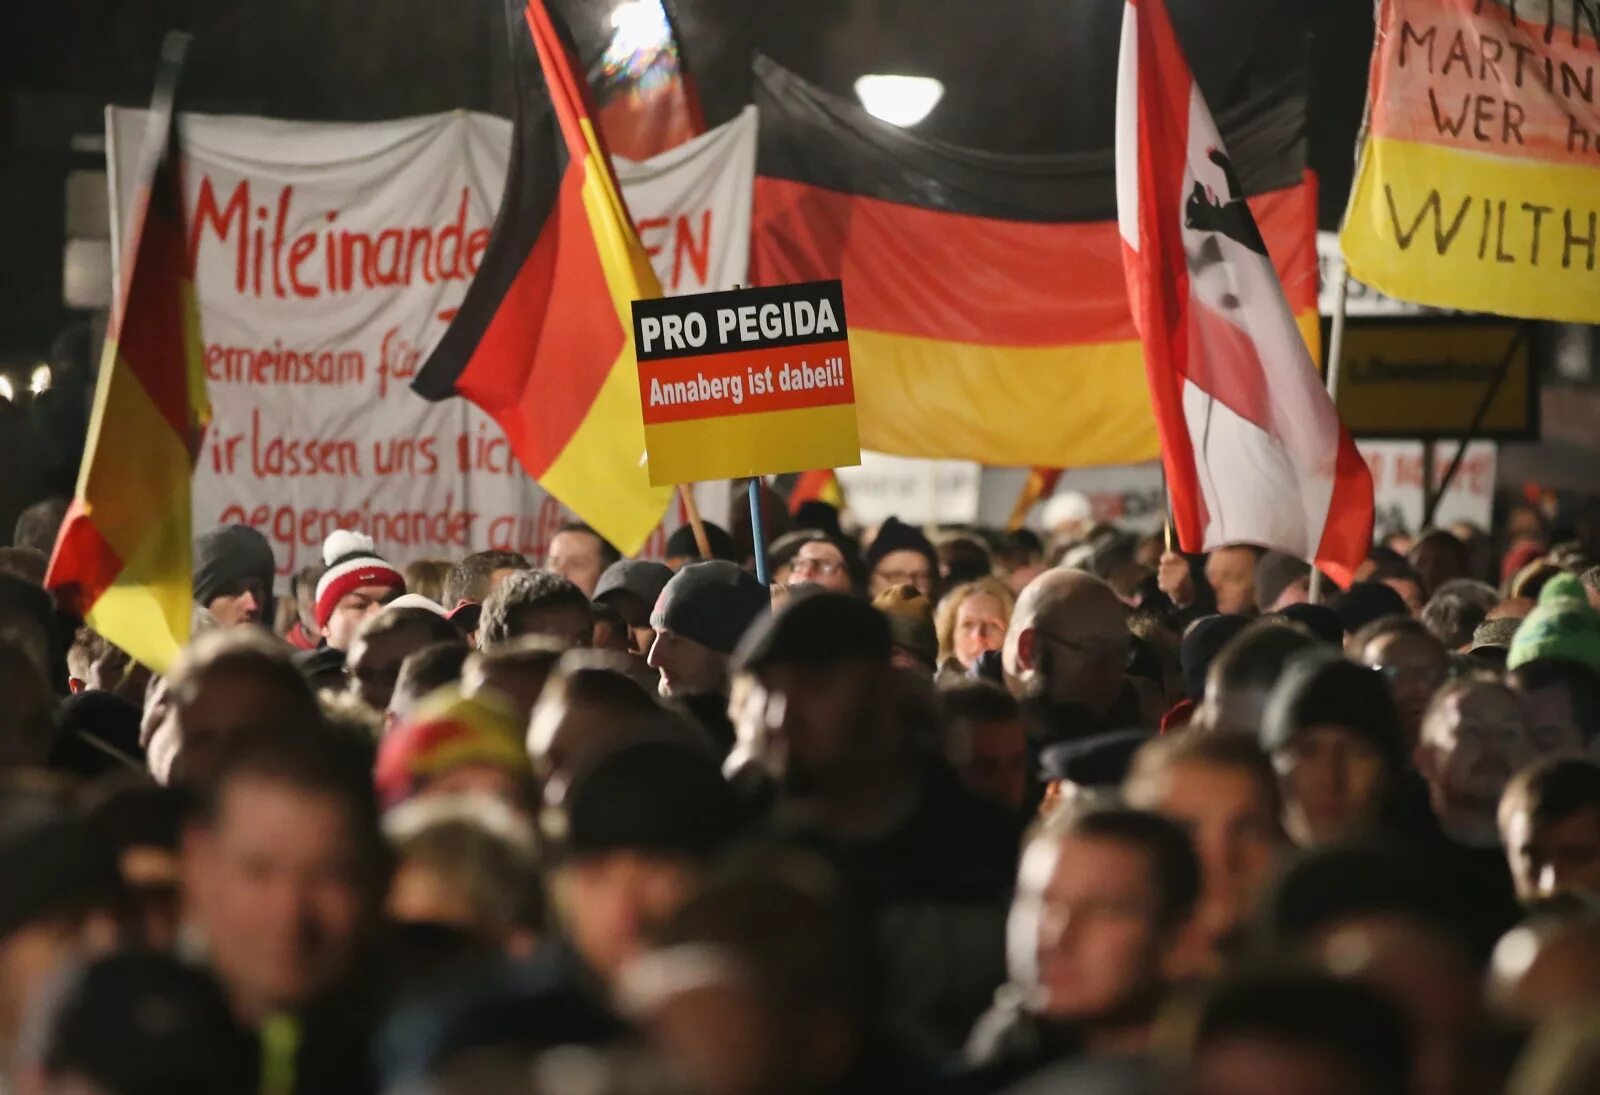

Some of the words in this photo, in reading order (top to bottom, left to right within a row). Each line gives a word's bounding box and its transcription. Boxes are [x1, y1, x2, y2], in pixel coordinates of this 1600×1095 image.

[1398, 20, 1594, 104] MARTIN
[1427, 87, 1526, 146] WER
[189, 174, 492, 298] Miteinande
[640, 311, 708, 353] PRO
[716, 298, 839, 345] PEGIDA
[204, 340, 364, 386] emeinsam
[650, 372, 744, 407] Annaberg
[747, 365, 774, 395] ist
[778, 357, 845, 392] dabei!!
[211, 428, 245, 476] ir
[252, 408, 360, 480] lassen
[374, 436, 438, 476] uns
